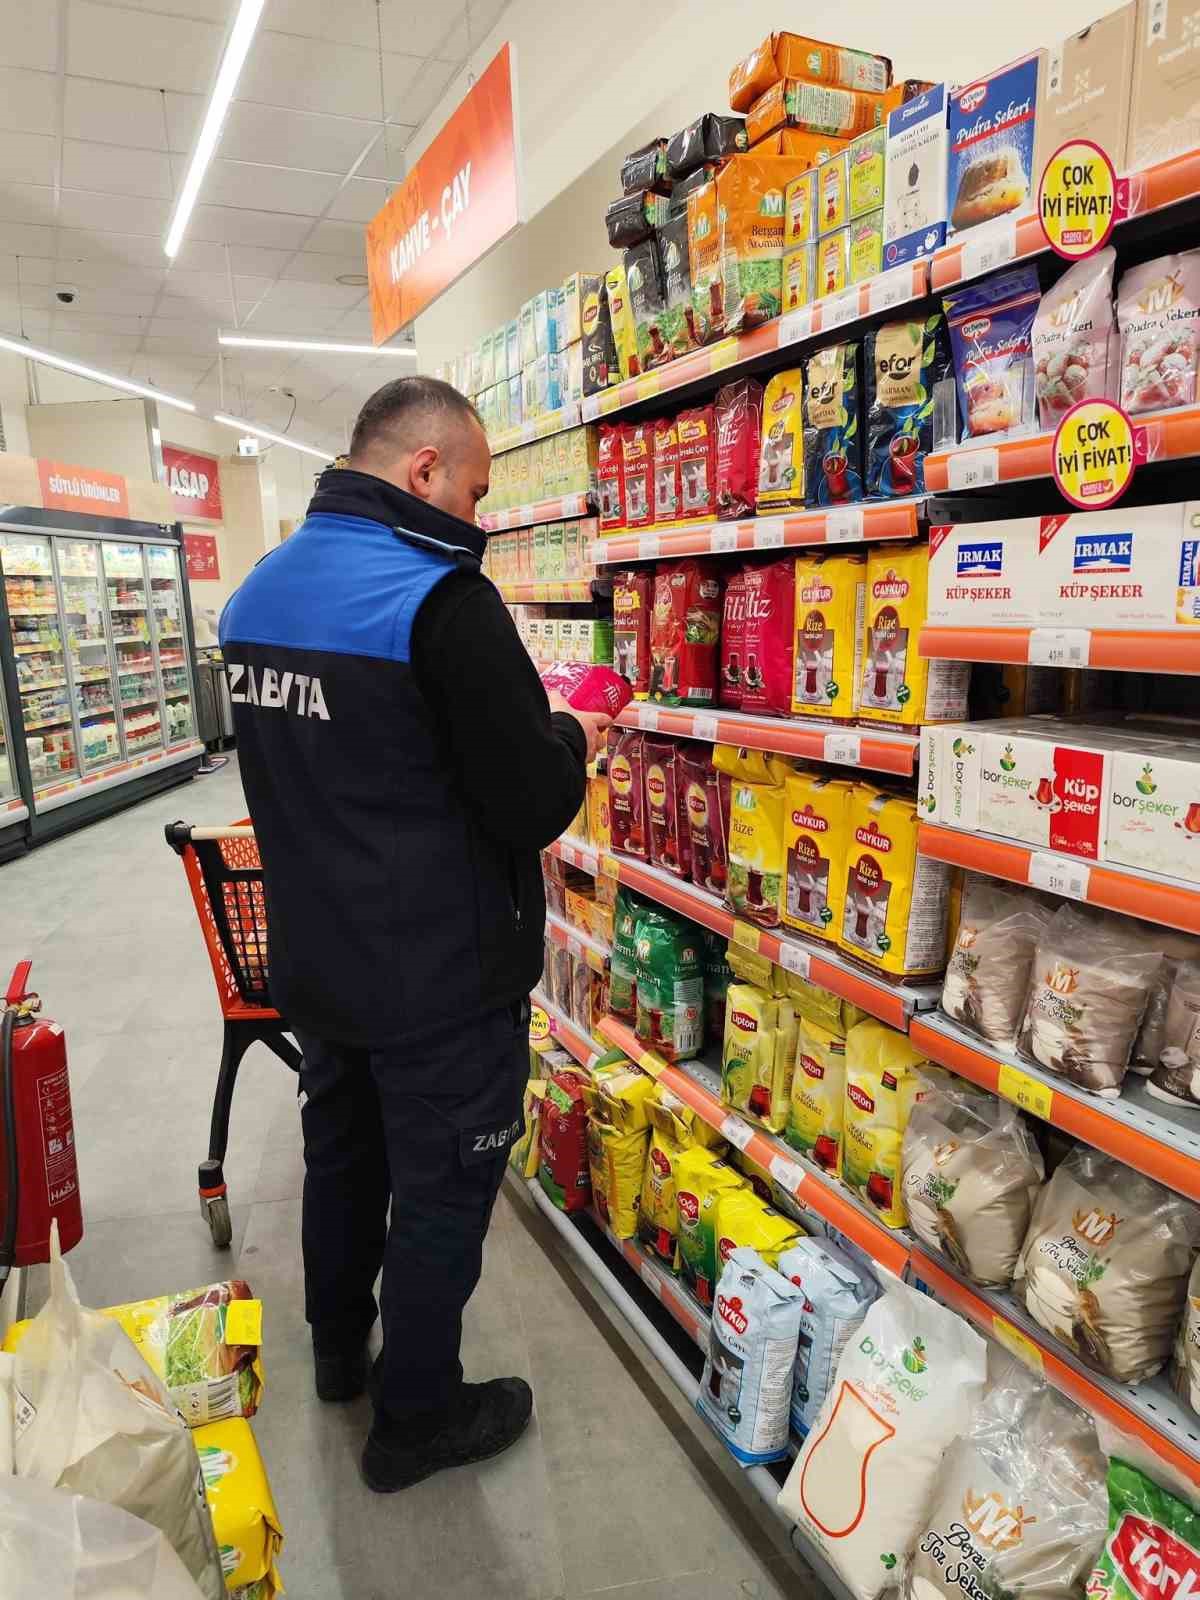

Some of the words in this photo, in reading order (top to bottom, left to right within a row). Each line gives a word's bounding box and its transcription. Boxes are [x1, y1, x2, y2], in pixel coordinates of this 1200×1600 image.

[956, 117, 991, 145] Pudra
[993, 98, 1031, 129] Şekeri
[1062, 166, 1094, 191] ÇOK
[1043, 193, 1062, 217] İYİ
[1066, 194, 1112, 216] FİYAT!
[390, 209, 431, 285] KAHVE
[441, 160, 472, 241] ÇAY
[879, 354, 916, 373] efor
[1077, 420, 1110, 447] ÇOK
[1058, 449, 1081, 475] İYİ
[1083, 445, 1131, 473] FİYAT!
[49, 474, 82, 498] SÜTLÜ
[957, 549, 1002, 564] IRMAK
[1075, 541, 1131, 559] IRMAK
[1182, 541, 1194, 586] IRMAK
[946, 586, 968, 599] KÜP
[970, 587, 1011, 602] ŞEKER
[1060, 582, 1088, 599] KÜP
[1090, 584, 1143, 601] ŞEKER
[227, 664, 331, 721] ZABITA
[927, 736, 935, 790] borşeker
[954, 761, 965, 818] borşeker
[982, 769, 1033, 791] borşeker
[1064, 777, 1099, 801] Küp
[1063, 800, 1098, 815] şeker
[1112, 791, 1180, 817] borşeker
[798, 841, 816, 857] Rize
[859, 861, 880, 880] Rize
[732, 1013, 756, 1030] Lipton
[848, 1085, 872, 1110] Lipton
[1077, 1212, 1112, 1243] M
[1060, 1235, 1089, 1261] Beyaz
[969, 1499, 1019, 1548] M
[920, 1531, 946, 1566] Toz
[944, 1522, 991, 1571] Beyaz
